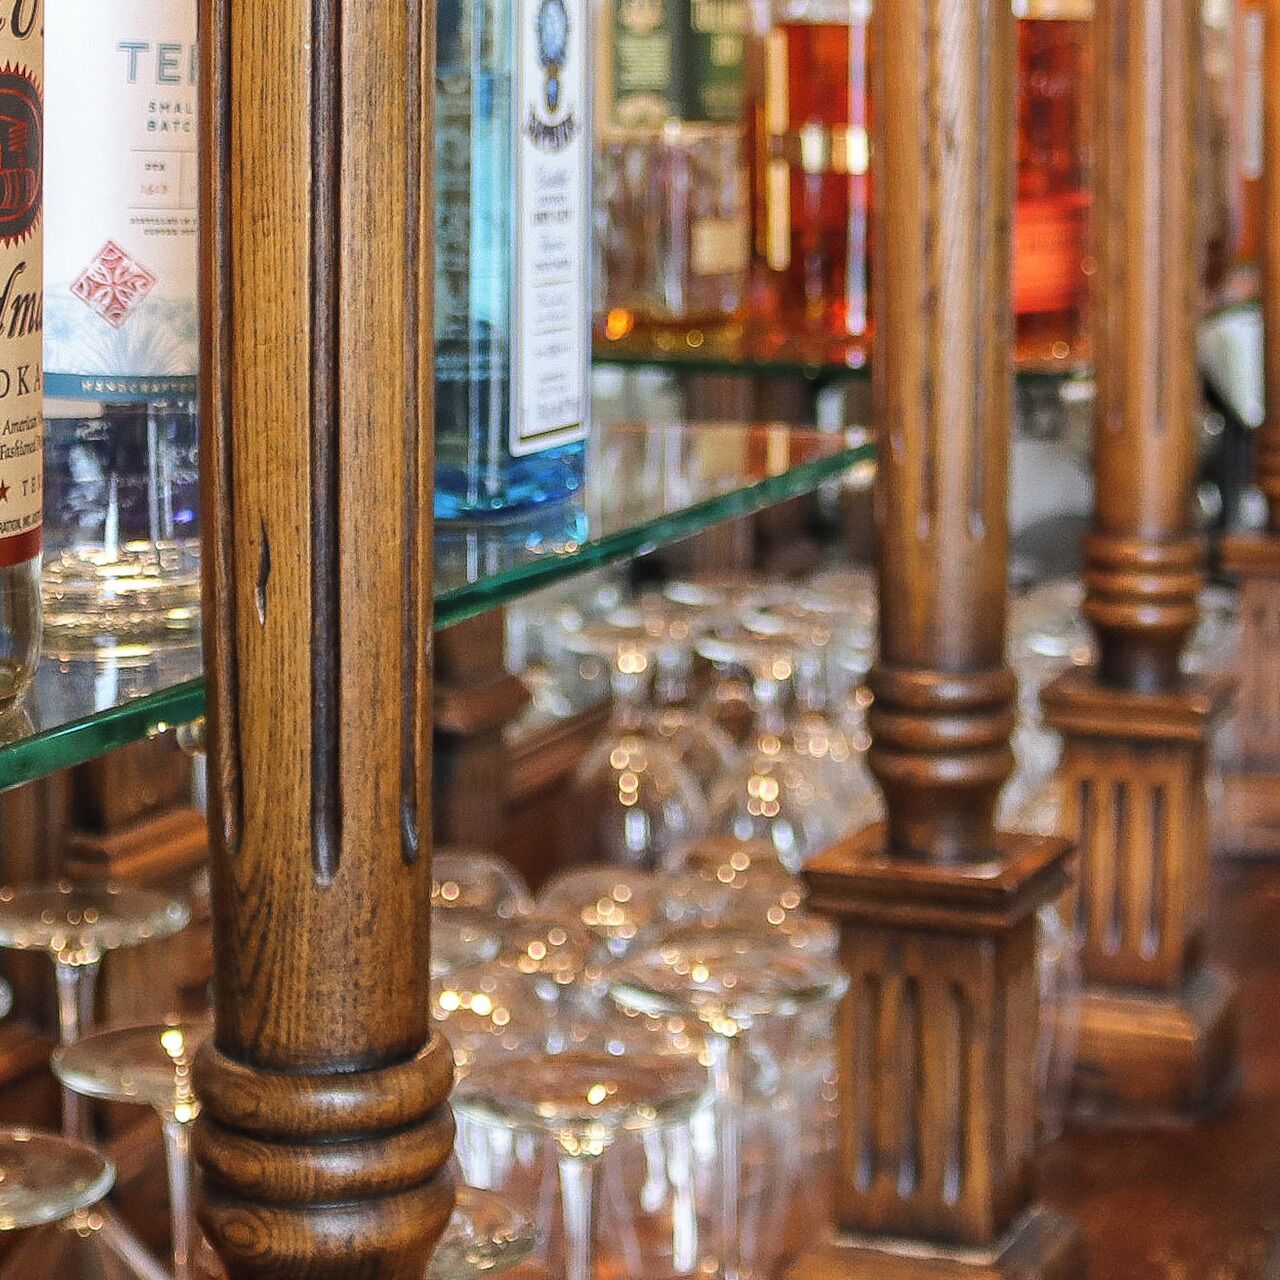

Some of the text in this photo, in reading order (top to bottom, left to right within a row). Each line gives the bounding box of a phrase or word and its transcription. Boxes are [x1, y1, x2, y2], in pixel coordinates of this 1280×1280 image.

[117, 41, 195, 86] TE
[148, 101, 193, 114] SMAL
[147, 120, 191, 132] BATC
